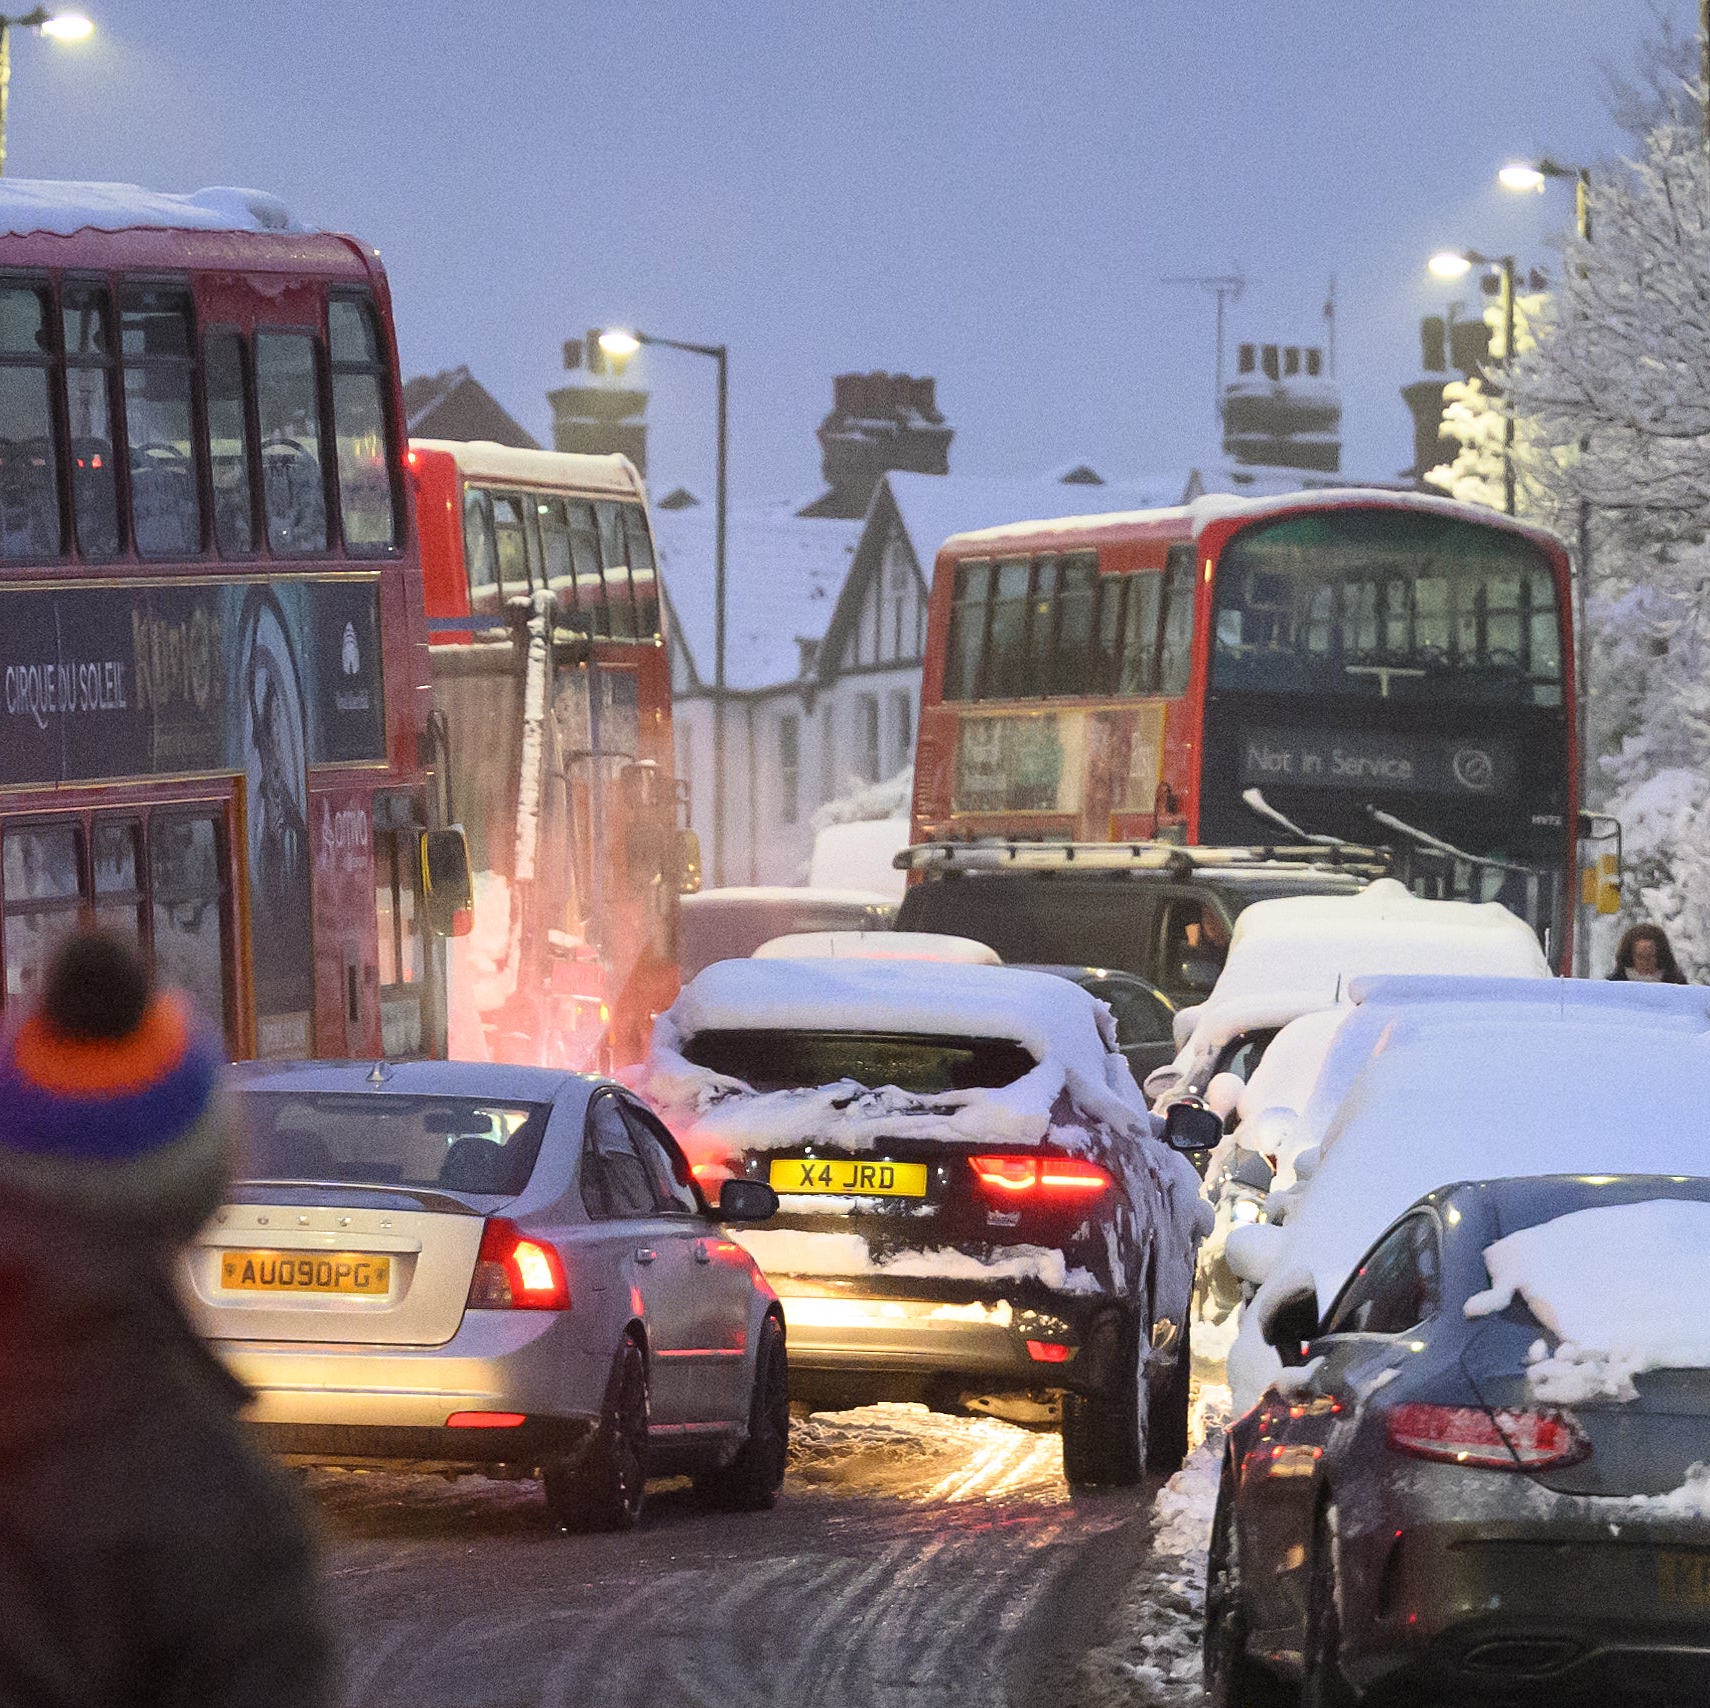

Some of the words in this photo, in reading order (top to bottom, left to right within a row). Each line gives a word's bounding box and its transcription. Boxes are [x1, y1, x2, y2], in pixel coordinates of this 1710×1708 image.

[5, 664, 57, 730] CIRQUE
[58, 662, 77, 712] DU
[79, 660, 127, 712] SOLEIL
[1246, 745, 1291, 772] Not
[1302, 749, 1322, 774] in
[1332, 747, 1412, 779] Service
[799, 1163, 833, 1187] X4
[842, 1164, 894, 1190] JRD
